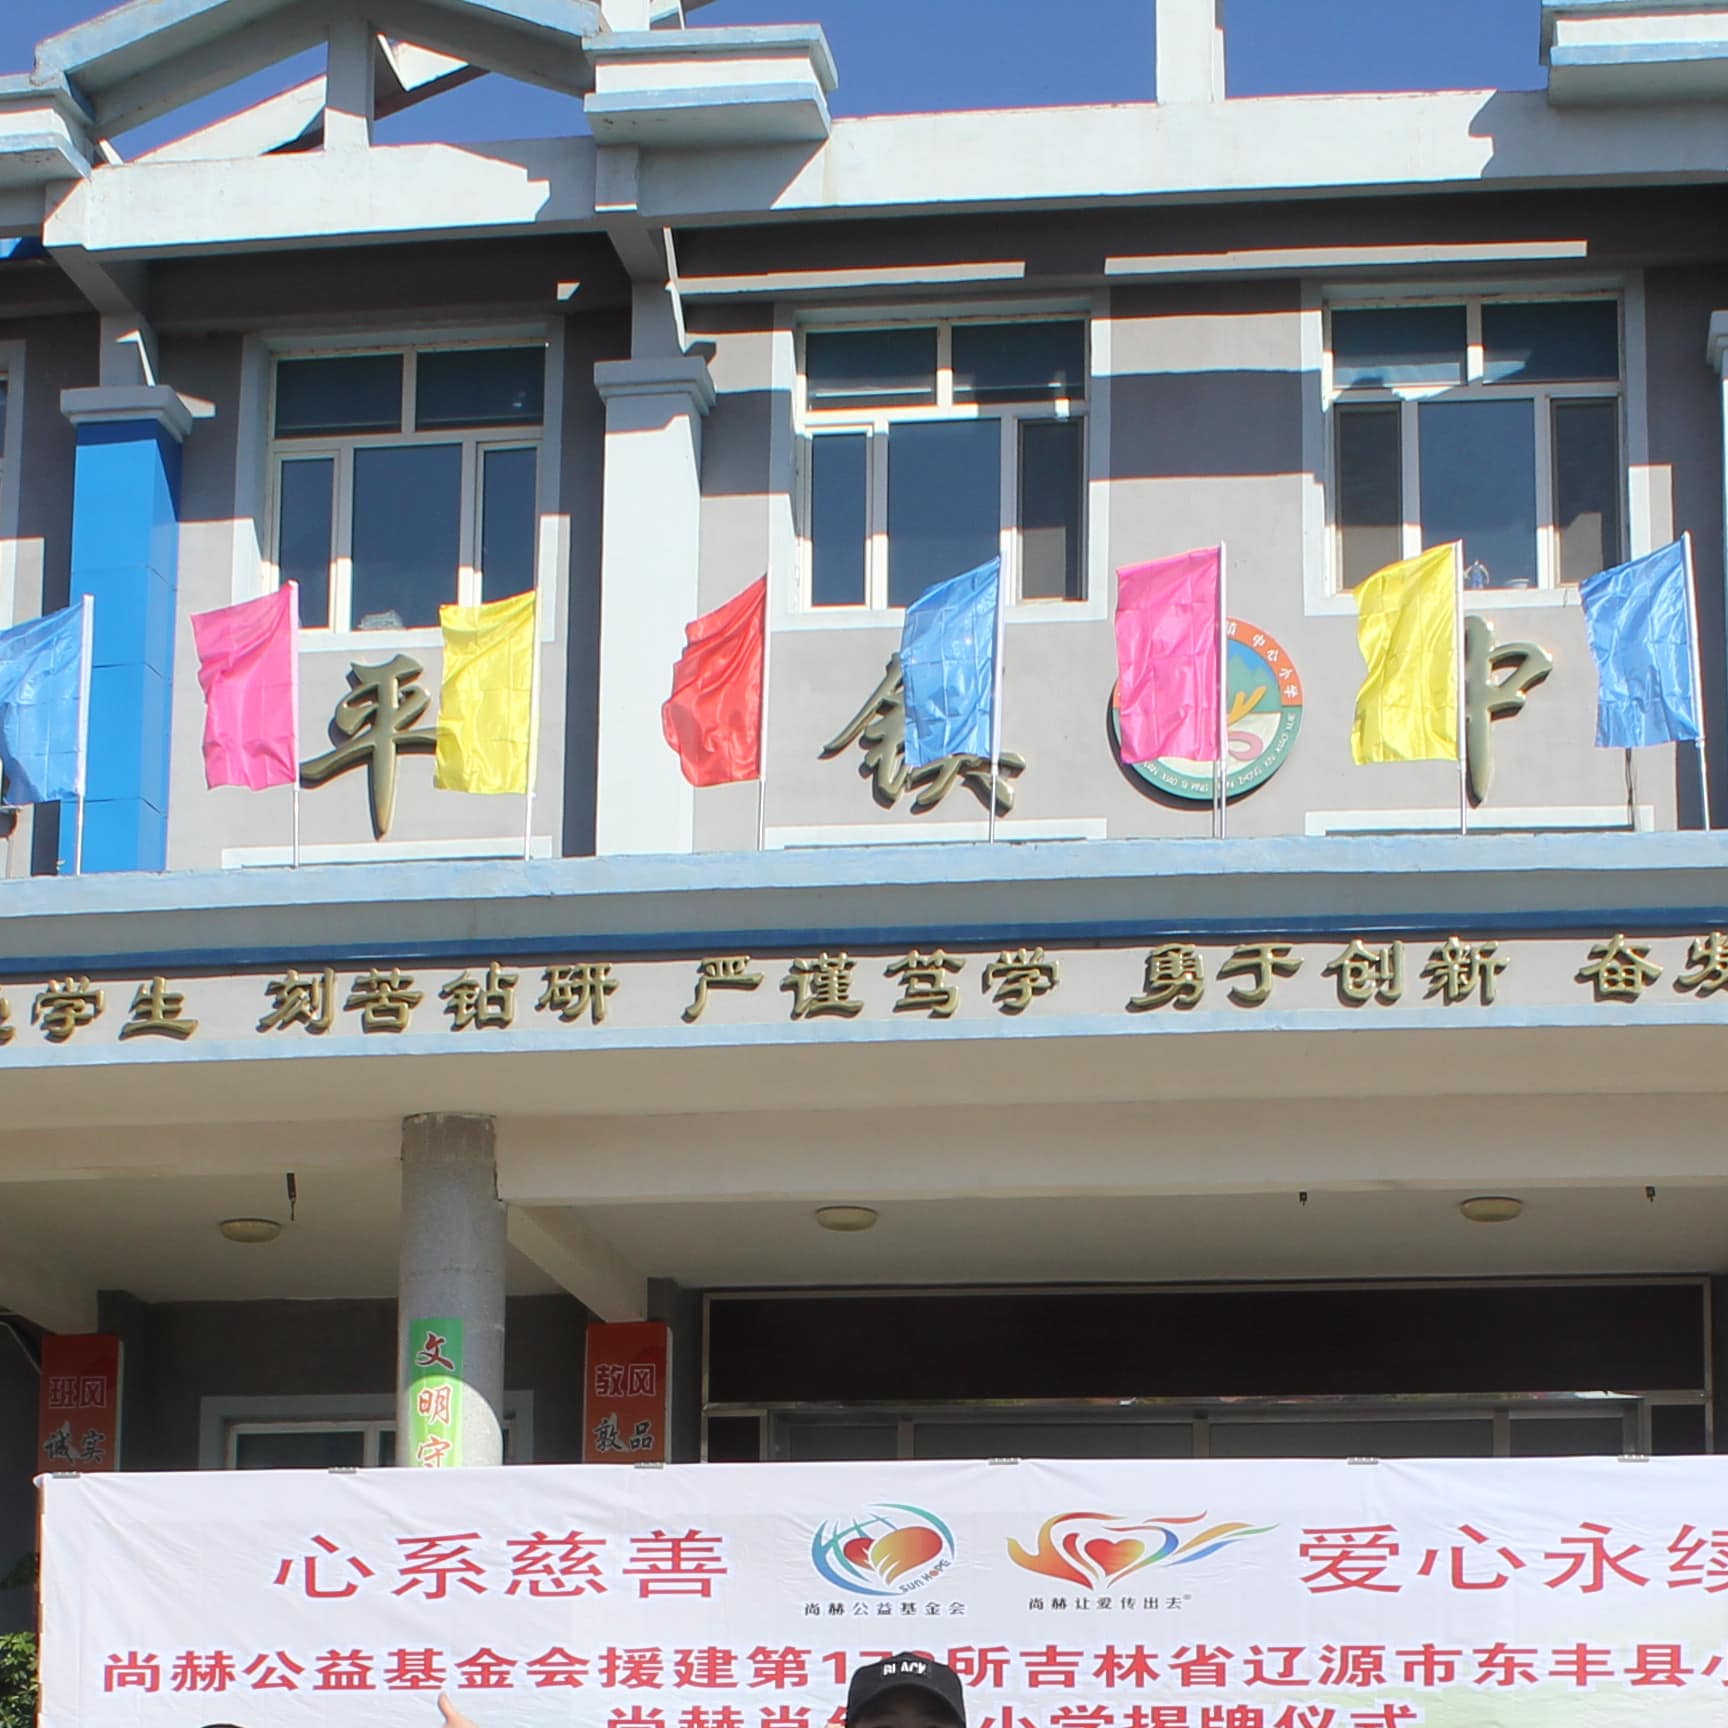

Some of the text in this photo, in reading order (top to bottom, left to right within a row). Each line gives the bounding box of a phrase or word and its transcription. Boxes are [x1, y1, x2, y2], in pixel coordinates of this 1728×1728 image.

[258, 961, 620, 1038] 刻苦钻研
[680, 948, 1061, 1024] 严谨笃学
[1128, 936, 1511, 1011] 勇于创新
[594, 1363, 657, 1398] 教风
[272, 1528, 729, 1602] 心系慈善
[804, 1602, 966, 1616] 尚赫公益基金会
[1028, 1596, 1183, 1610] 尚赫让爱传出去
